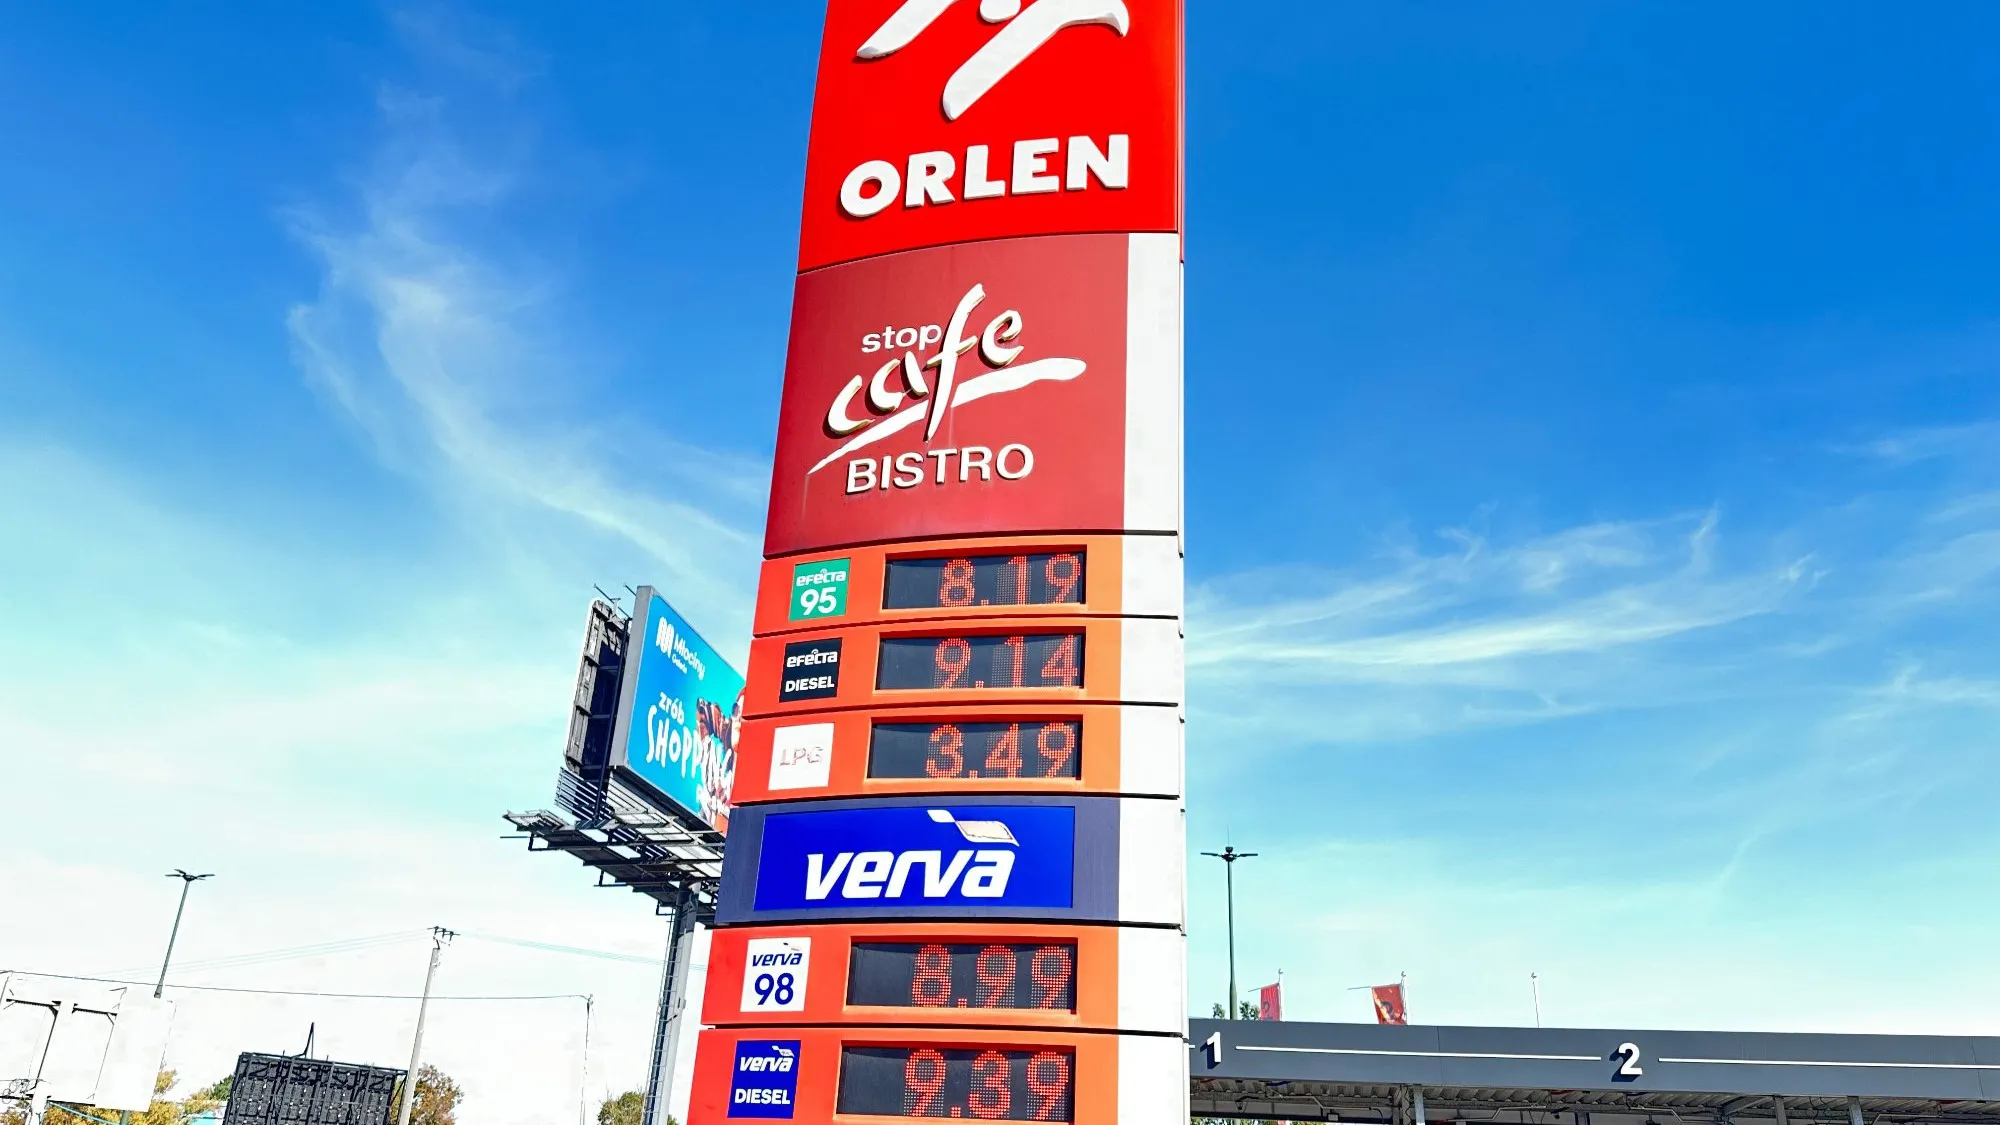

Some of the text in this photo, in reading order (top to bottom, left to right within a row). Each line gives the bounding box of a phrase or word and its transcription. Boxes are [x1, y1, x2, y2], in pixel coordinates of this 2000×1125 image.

[840, 134, 1129, 217] ORLEN
[862, 323, 942, 353] stop
[827, 283, 1024, 442] cafe
[846, 443, 1034, 494] BISTRO
[939, 554, 1081, 607] 8.19
[800, 587, 837, 615] 95
[934, 634, 1078, 689] 9.14
[785, 676, 835, 692] DIESEL
[659, 692, 684, 725] zrób
[780, 745, 824, 766] LPG
[925, 722, 1076, 779] 3.49
[805, 850, 1016, 900] verva
[752, 953, 803, 967] verva
[911, 944, 1072, 1009] 8.99
[754, 972, 795, 1005] 98
[739, 1056, 794, 1073] verva
[1207, 1031, 1222, 1072] 1
[1619, 1042, 1643, 1075] 2
[734, 1088, 791, 1105] DIESEL
[904, 1049, 1069, 1120] 9.39
